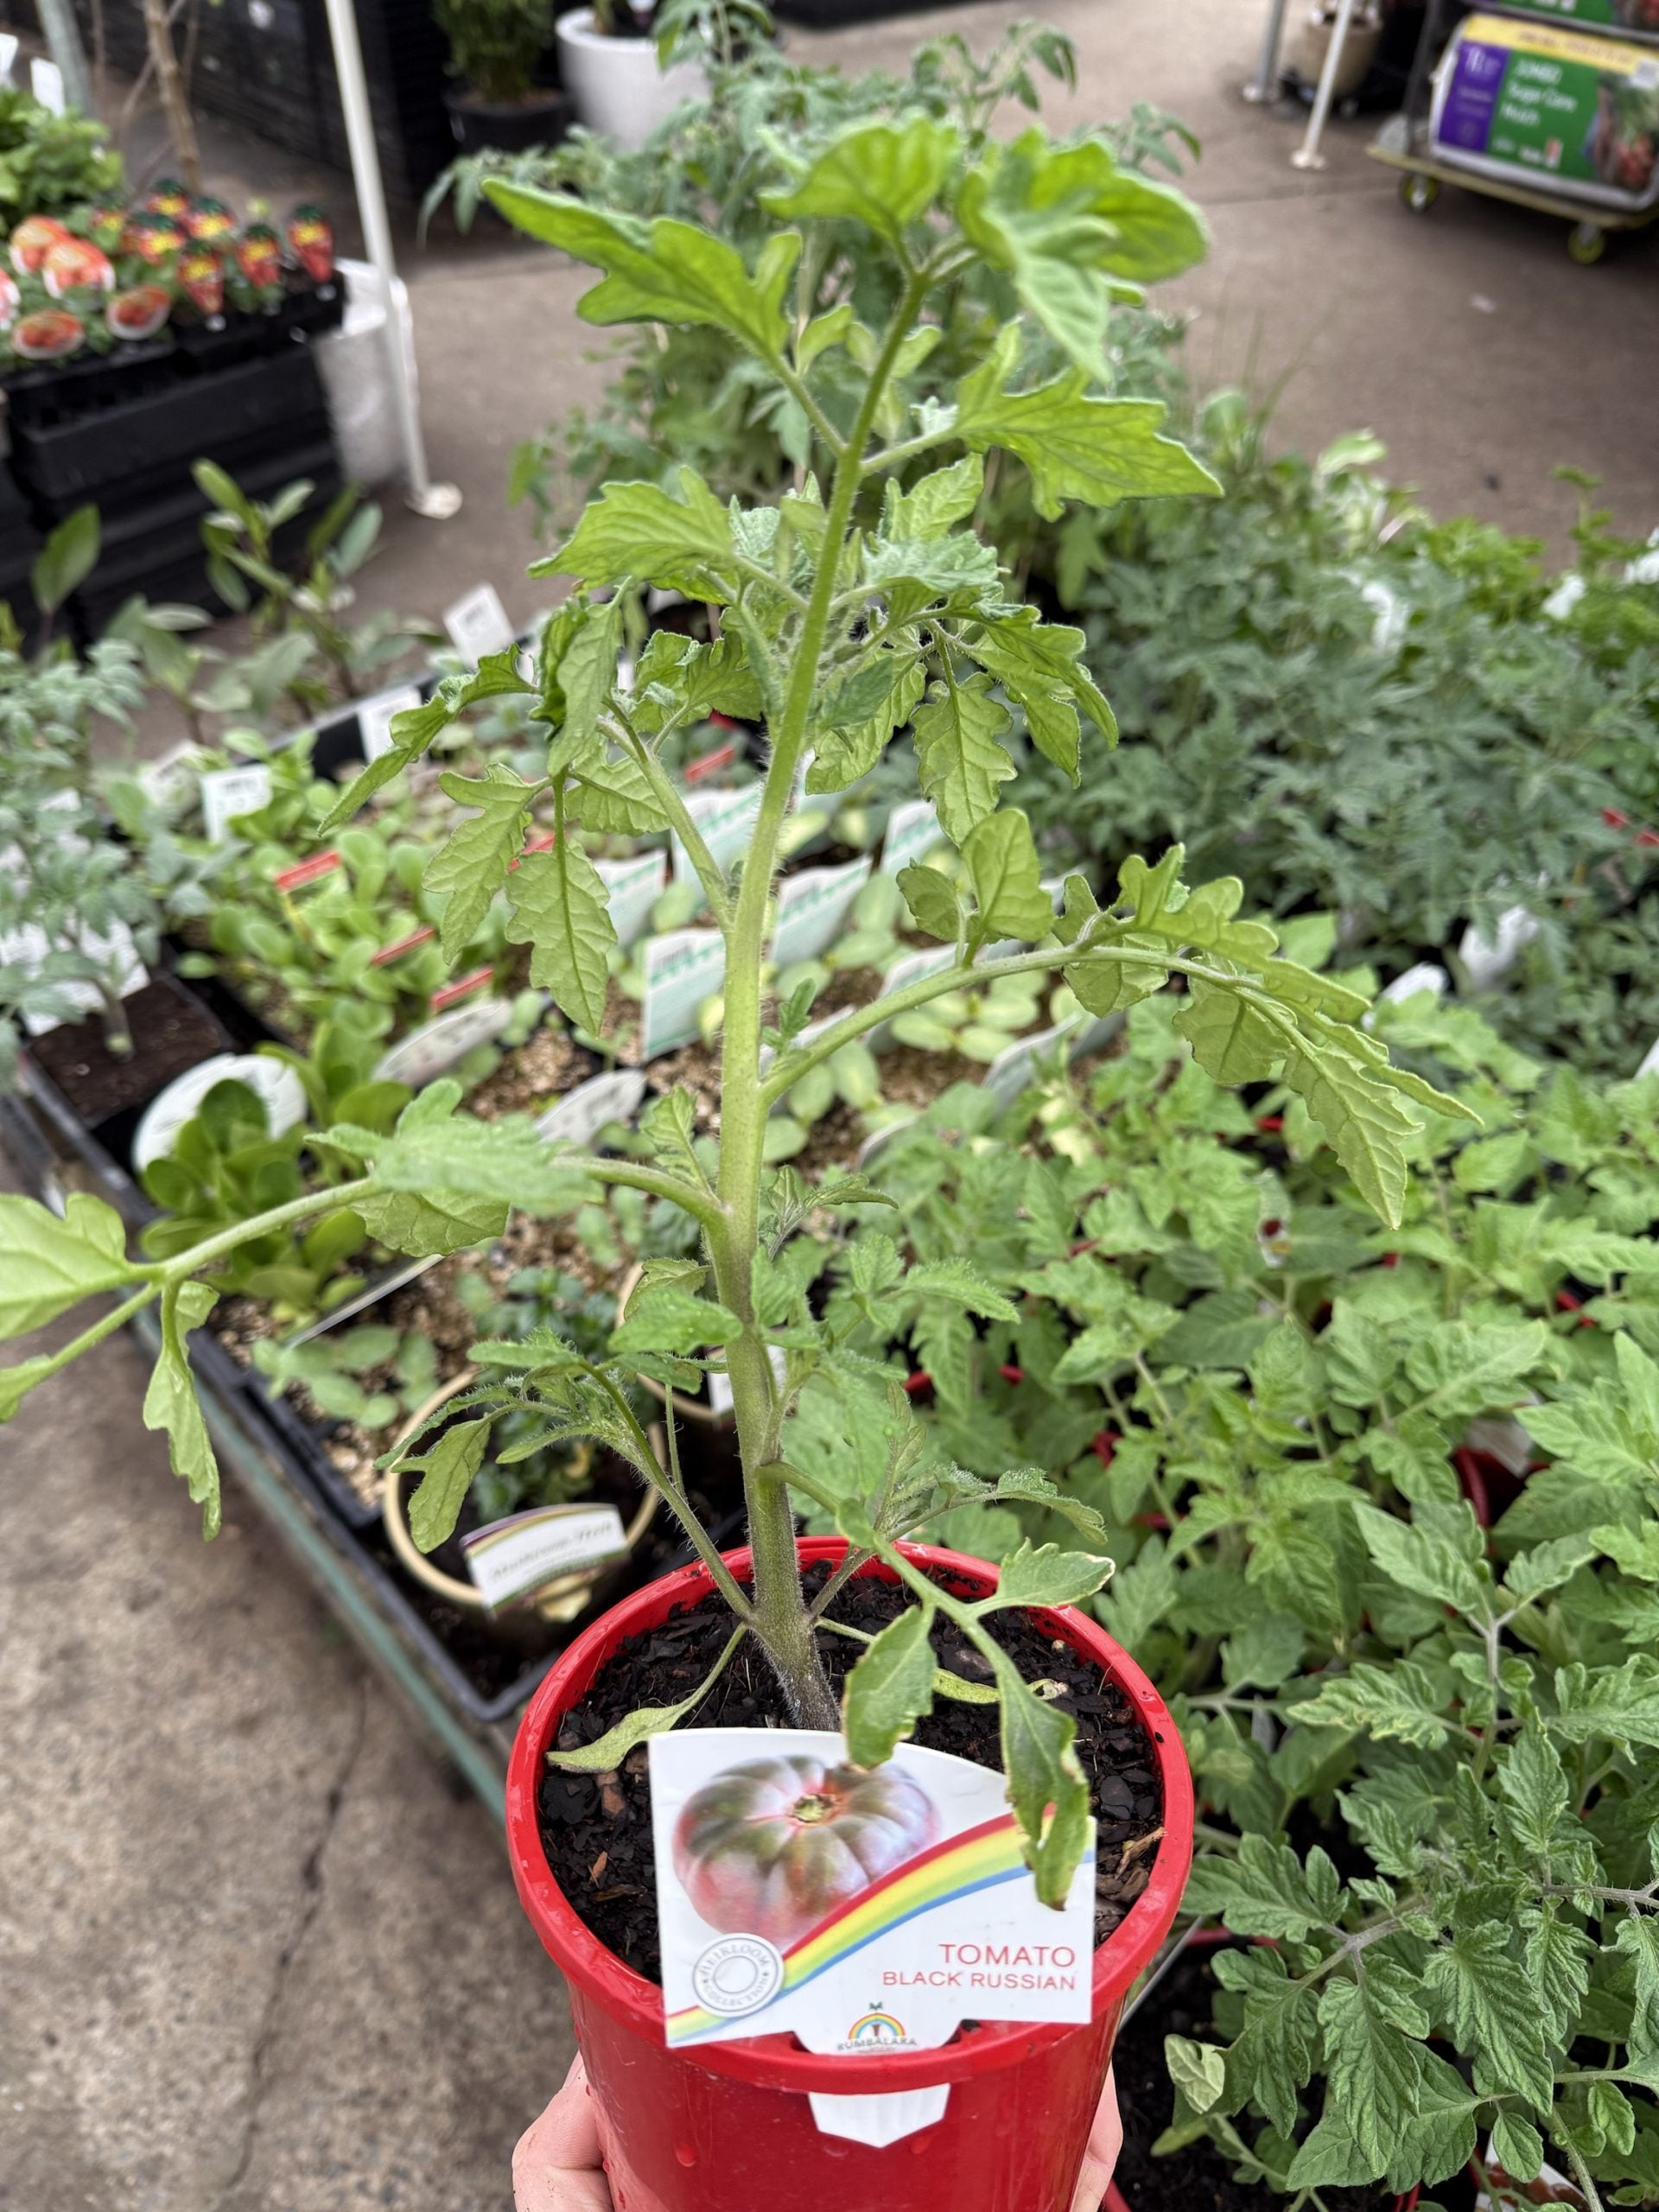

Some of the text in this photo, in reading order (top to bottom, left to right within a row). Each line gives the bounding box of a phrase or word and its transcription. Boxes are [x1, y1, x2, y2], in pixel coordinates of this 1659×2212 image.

[699, 1943, 771, 1977] HEIRLOOM
[938, 1943, 1076, 1967] TOMATO
[703, 1976, 768, 2007] COLLECTION
[882, 1971, 1076, 1990] BLACK RUSSIAN
